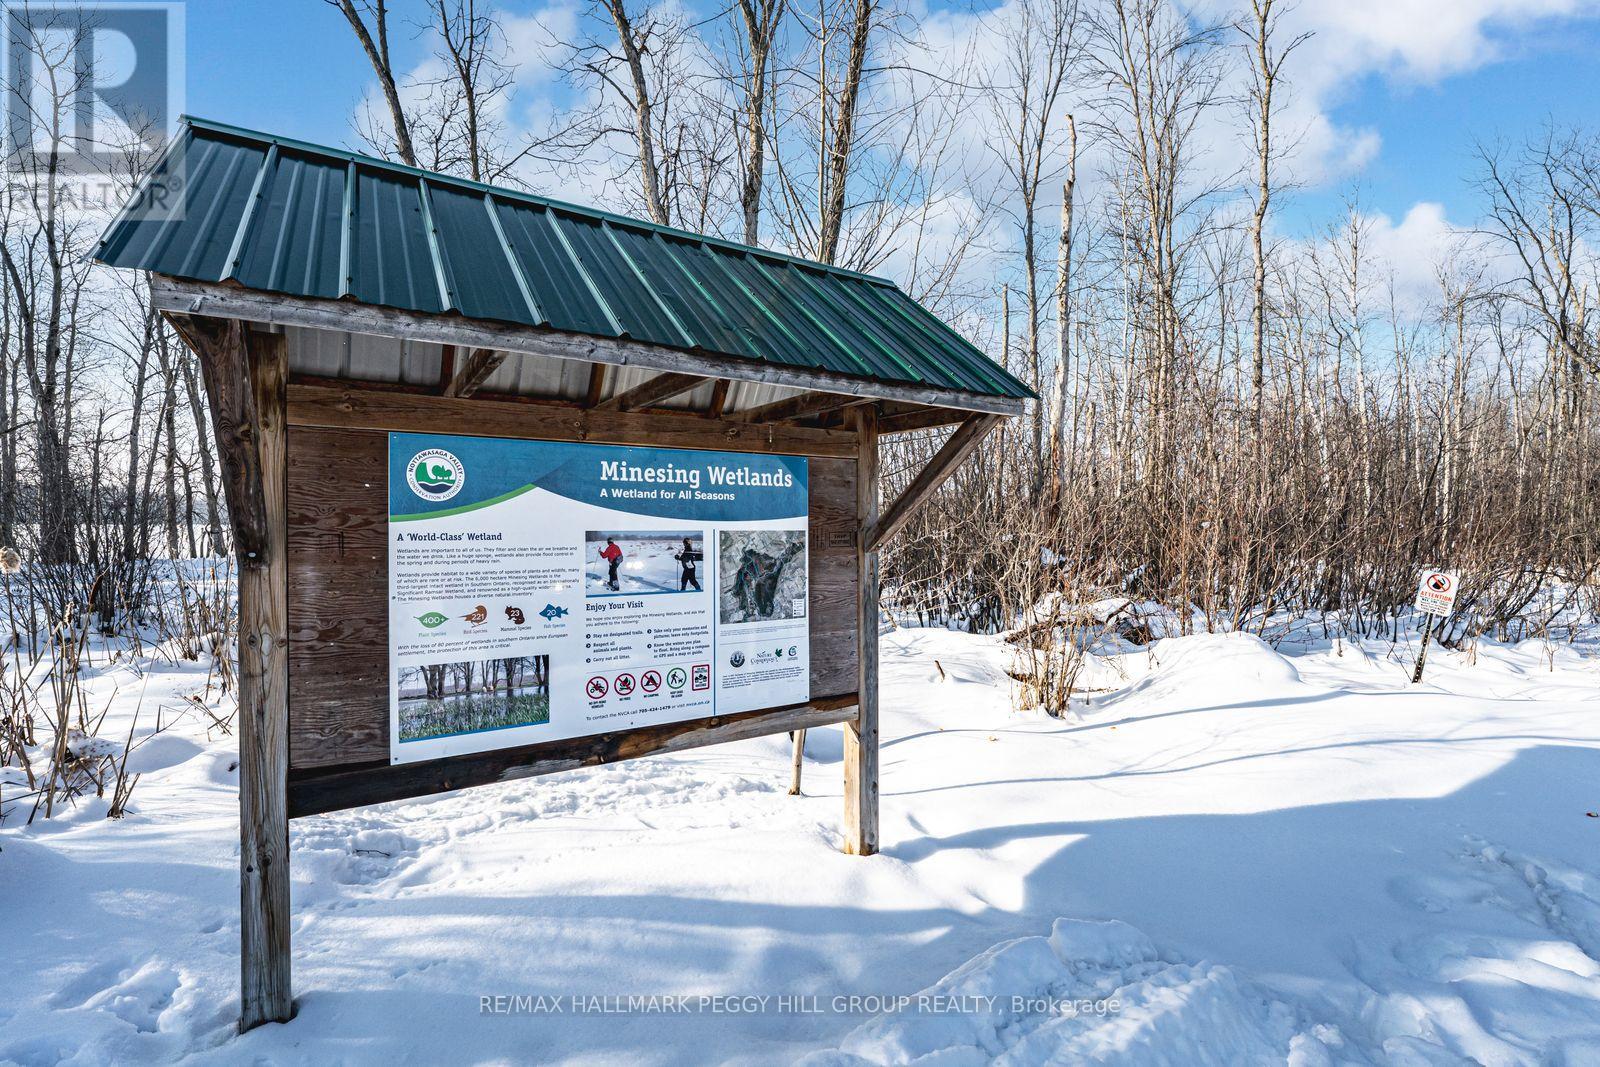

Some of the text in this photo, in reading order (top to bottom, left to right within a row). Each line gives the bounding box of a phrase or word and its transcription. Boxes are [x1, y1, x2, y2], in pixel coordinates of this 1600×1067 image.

[408, 450, 463, 474] NOTTAWASAGA VALLEY
[600, 461, 792, 489] Minesing Wetlands
[409, 478, 462, 499] CONSERVATION AUTHORITY
[600, 489, 735, 500] A Wetland for All Seasons
[586, 603, 606, 612] Enjoy
